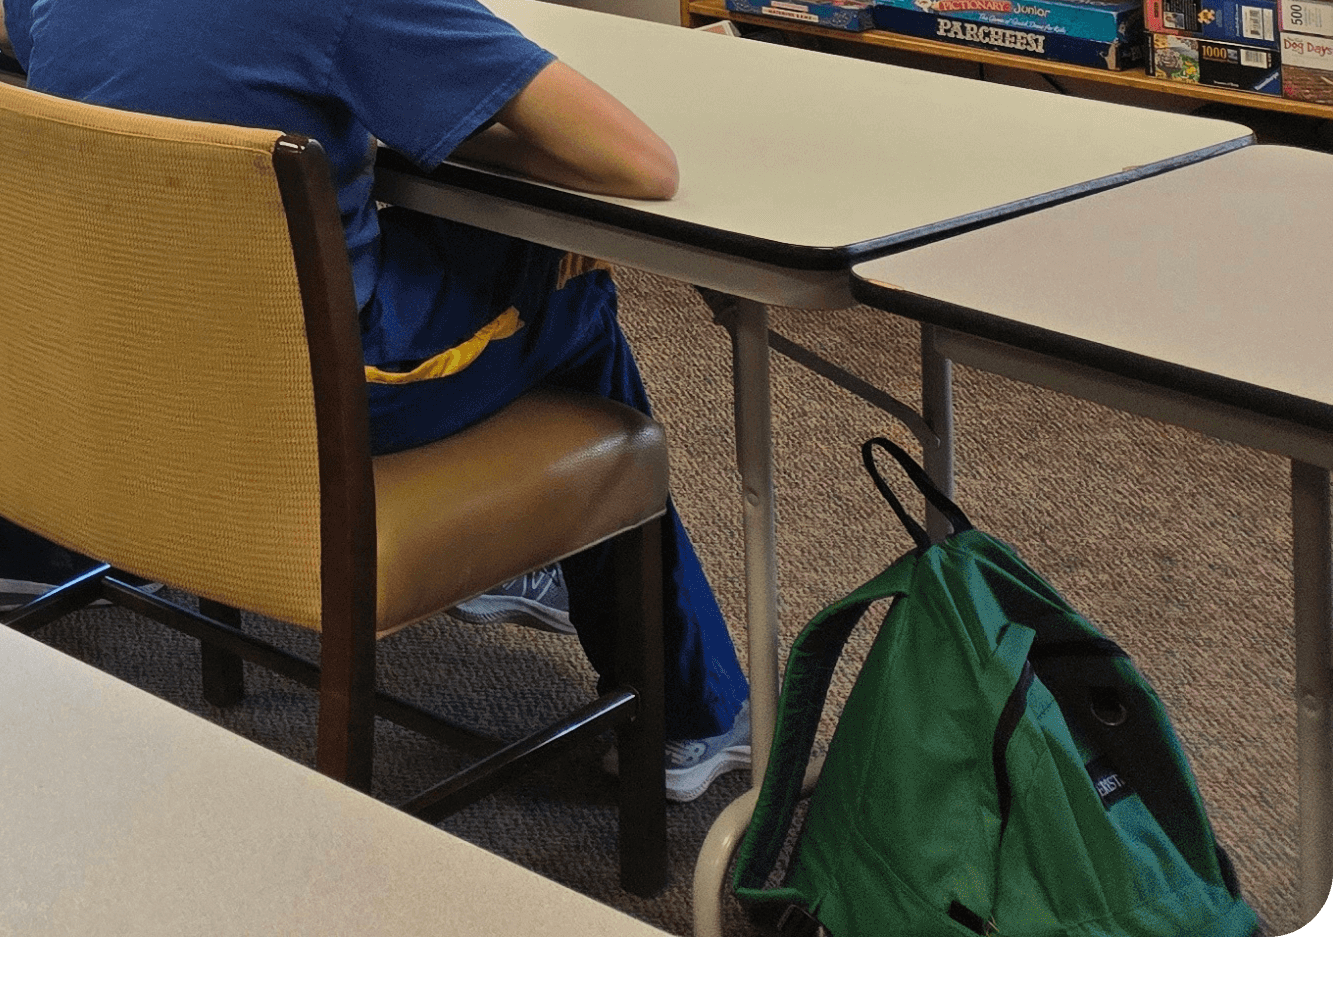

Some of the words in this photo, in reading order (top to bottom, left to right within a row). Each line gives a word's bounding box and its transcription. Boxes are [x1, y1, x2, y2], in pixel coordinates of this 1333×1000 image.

[940, 0, 1006, 12] PICTIONARY
[1013, 3, 1051, 18] Junior
[1290, 4, 1303, 26] 500
[936, 17, 1046, 53] PARCHEESI
[1201, 45, 1228, 60] 1000
[1283, 38, 1304, 55] Dog
[1306, 41, 1333, 57] Days
